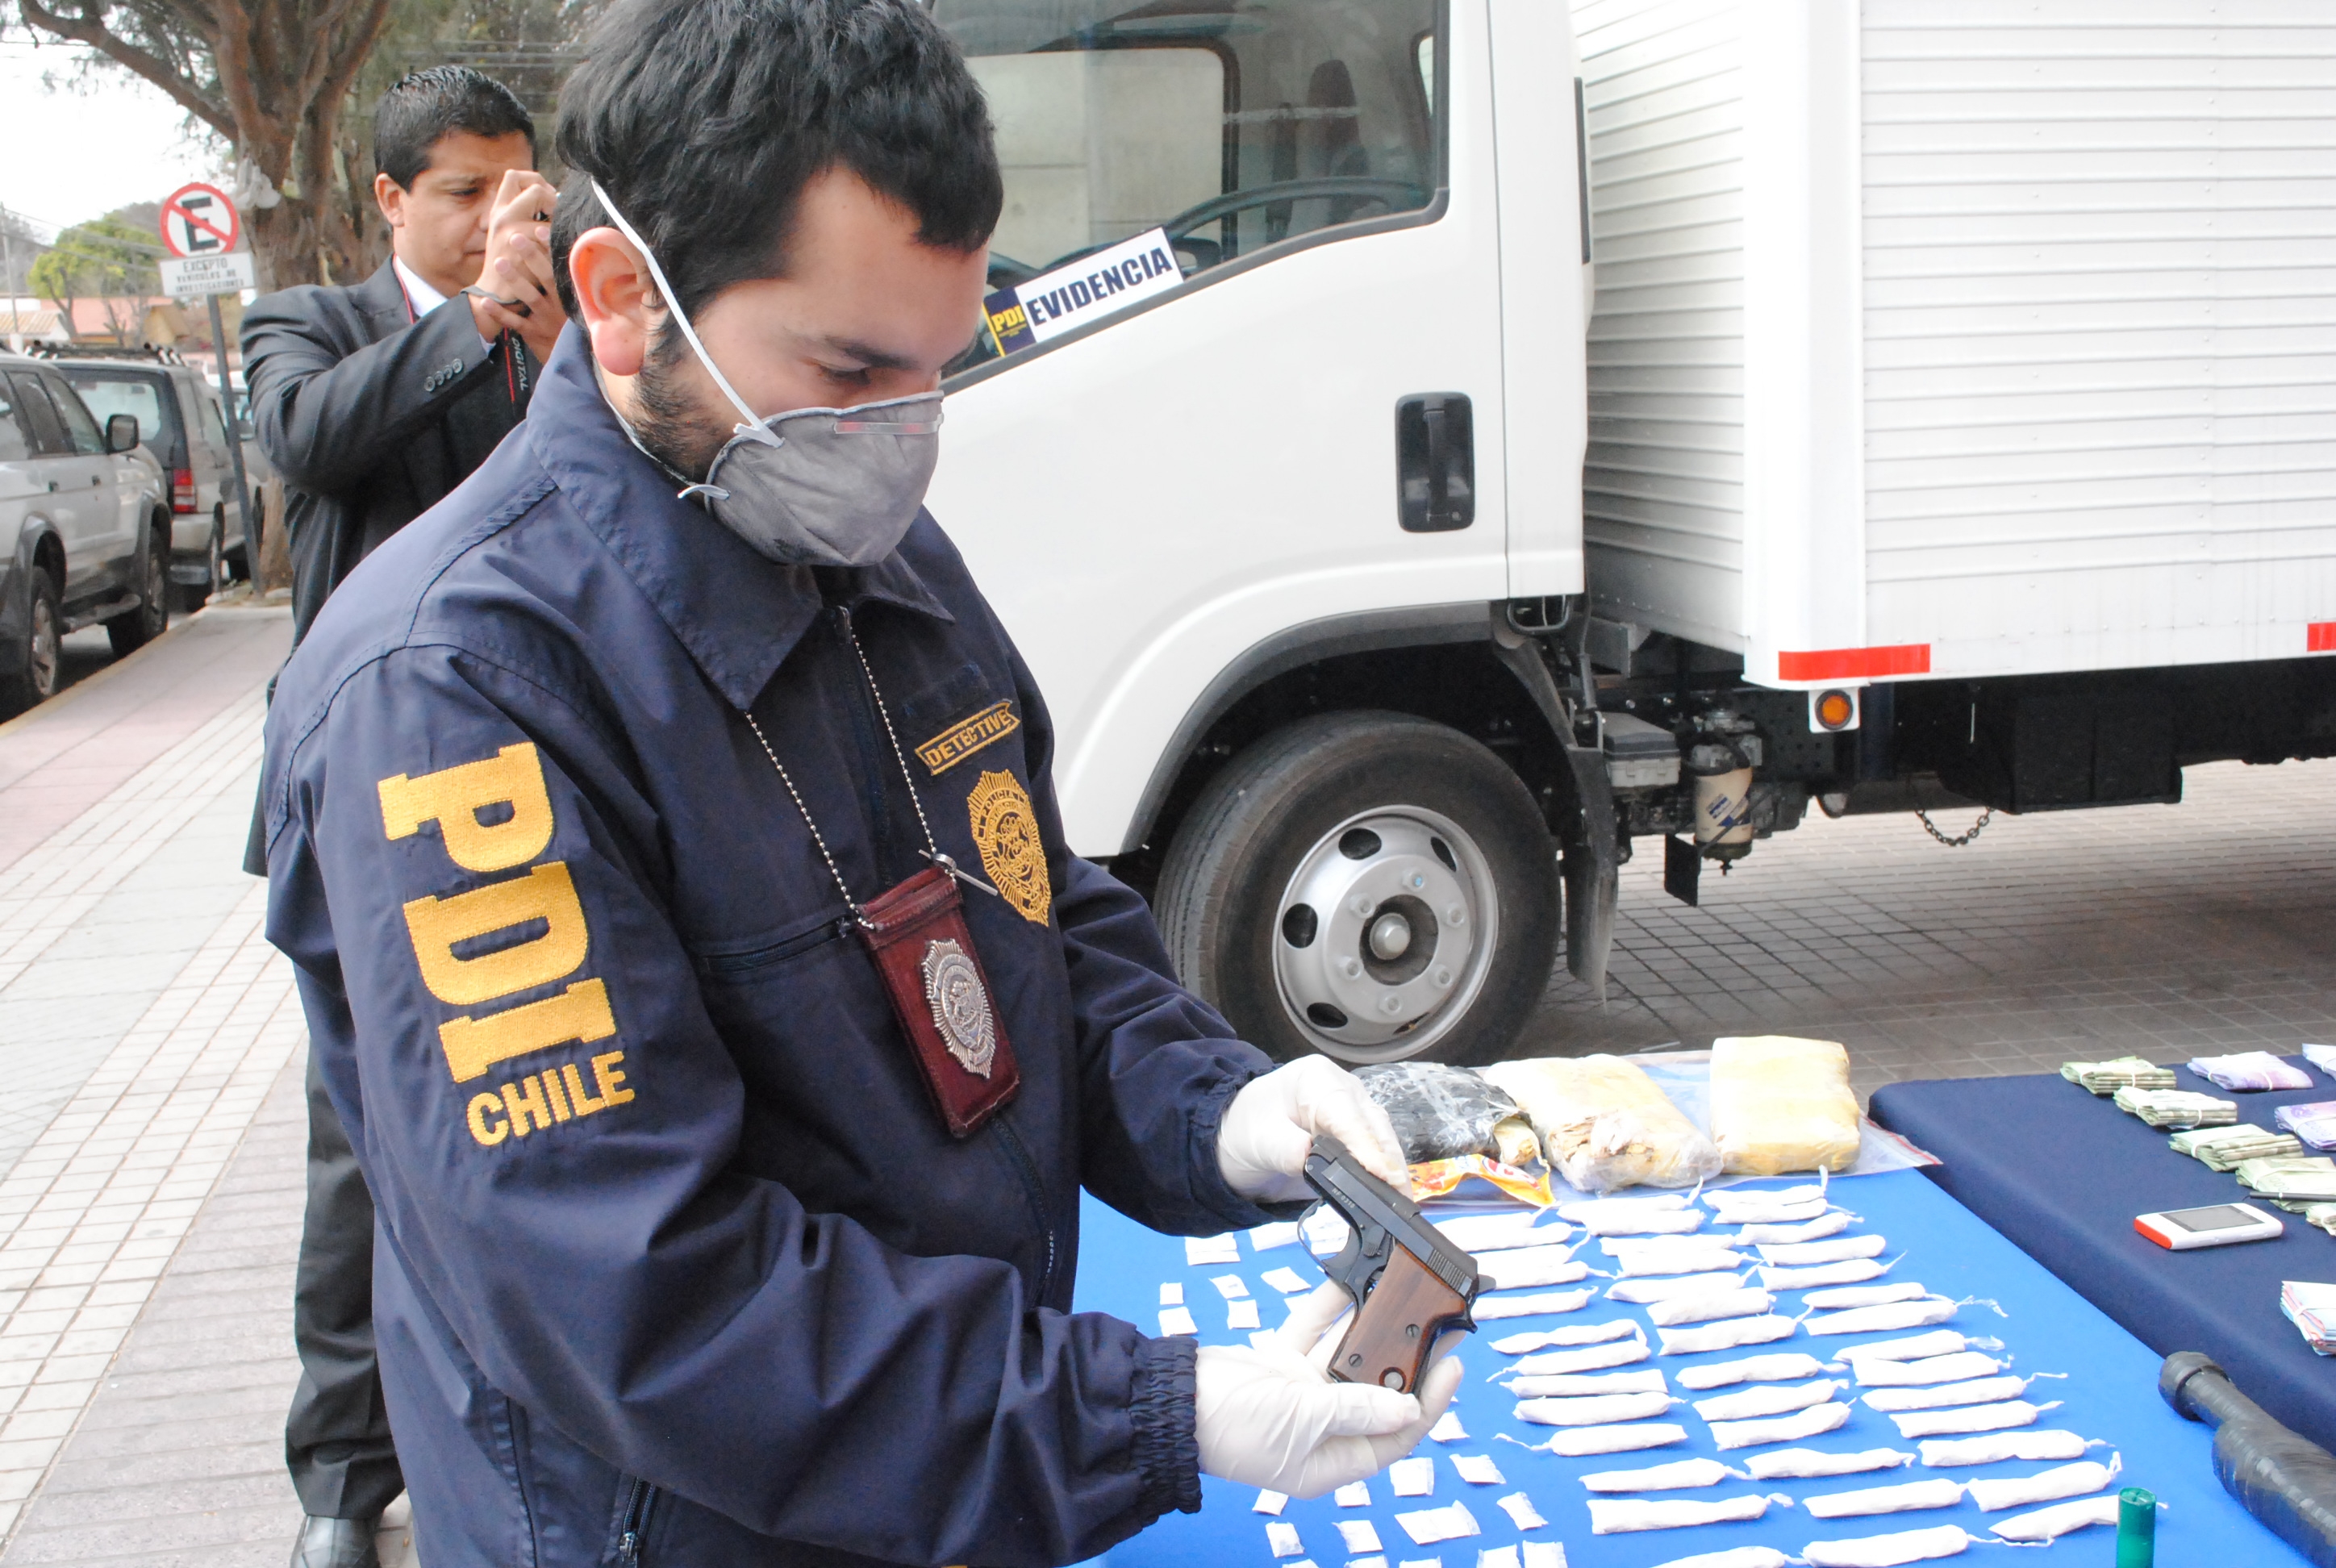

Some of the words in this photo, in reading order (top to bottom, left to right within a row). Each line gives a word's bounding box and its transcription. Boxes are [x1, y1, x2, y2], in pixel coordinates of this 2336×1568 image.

[181, 196, 219, 252] E
[183, 257, 228, 273] EXCEPTO
[991, 305, 1025, 332] PDI
[1025, 247, 1173, 327] EVIDENCIA
[511, 336, 528, 391] DIGITAL
[924, 709, 1012, 766] DETECTIVE
[980, 790, 1015, 817] POLICIA
[378, 741, 616, 1083] PDI
[467, 1050, 636, 1147] CHILE
